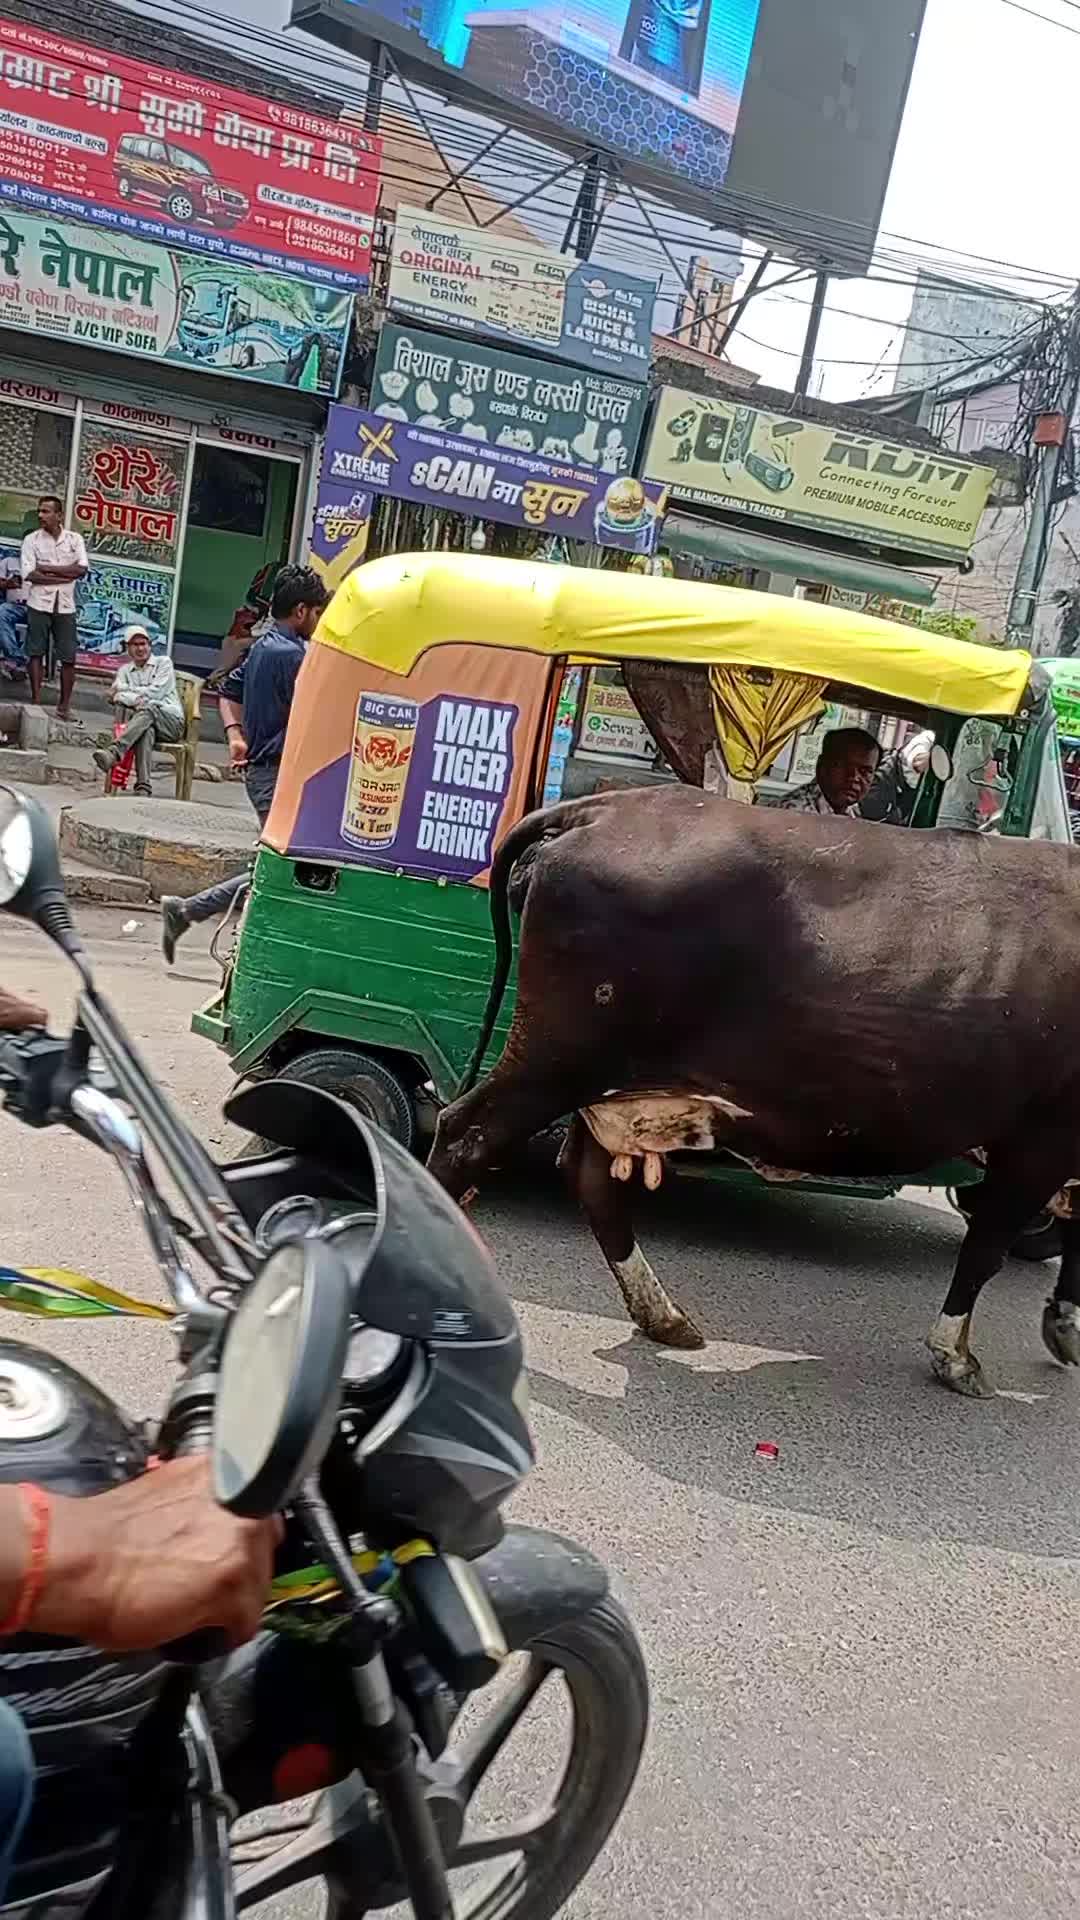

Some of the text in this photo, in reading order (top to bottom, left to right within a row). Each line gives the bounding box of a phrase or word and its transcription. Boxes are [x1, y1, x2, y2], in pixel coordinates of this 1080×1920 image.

[0, 48, 76, 100] म्राट
[39, 227, 159, 308] नेपाल
[399, 249, 484, 281] ORIGINAL
[413, 272, 467, 294] ENERGY
[430, 288, 477, 308] DRINK!
[74, 319, 99, 339] A/C
[102, 325, 123, 343] VIP
[125, 332, 157, 351] SOFA
[565, 322, 600, 345] LASI
[601, 334, 648, 360] PASAL
[581, 313, 622, 337] JUICE
[393, 336, 632, 424] विशाल जुस एण्ड लस्सी पसल
[334, 450, 390, 479] XTREME
[410, 455, 496, 500] sCAN
[492, 479, 523, 505] मा
[522, 480, 590, 525] सुन
[672, 486, 692, 498] MAA
[749, 502, 788, 519] TRADERS
[819, 465, 957, 508] Connecting Forever
[74, 487, 178, 542] नेपाल
[803, 486, 973, 532] PREMIUM MOBILE ACCESSORIES
[364, 701, 413, 719] BIG CAN
[434, 701, 512, 753] MAX
[431, 744, 508, 793] TIGER
[422, 790, 498, 828] ENERGY
[416, 820, 490, 863] DRINK
